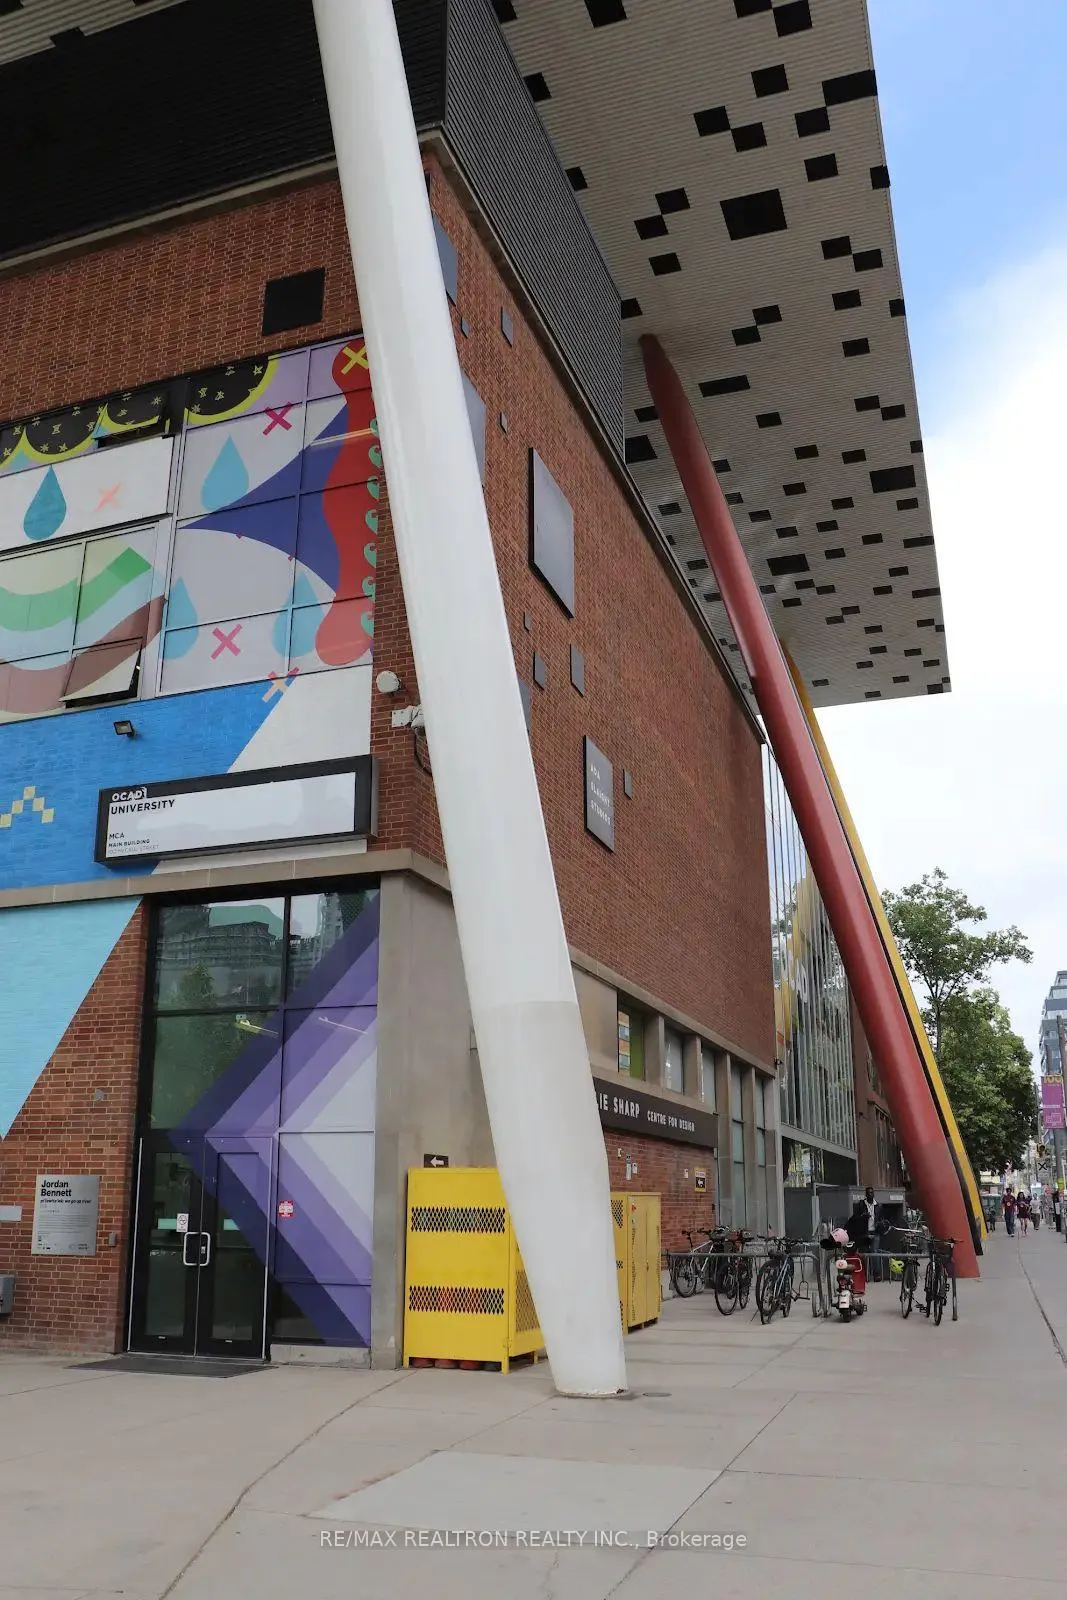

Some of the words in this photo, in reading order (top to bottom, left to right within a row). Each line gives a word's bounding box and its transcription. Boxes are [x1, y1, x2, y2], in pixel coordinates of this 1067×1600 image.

[111, 799, 175, 815] UNIVERSITY
[109, 832, 125, 840] MCA
[599, 1093, 608, 1111] IE
[613, 1096, 640, 1118] SHARP
[647, 1110, 667, 1125] CENTRE
[668, 1115, 678, 1128] FOR
[679, 1118, 695, 1132] DESIGN
[41, 1180, 69, 1188] Jordan
[41, 1188, 72, 1197] Bennett
